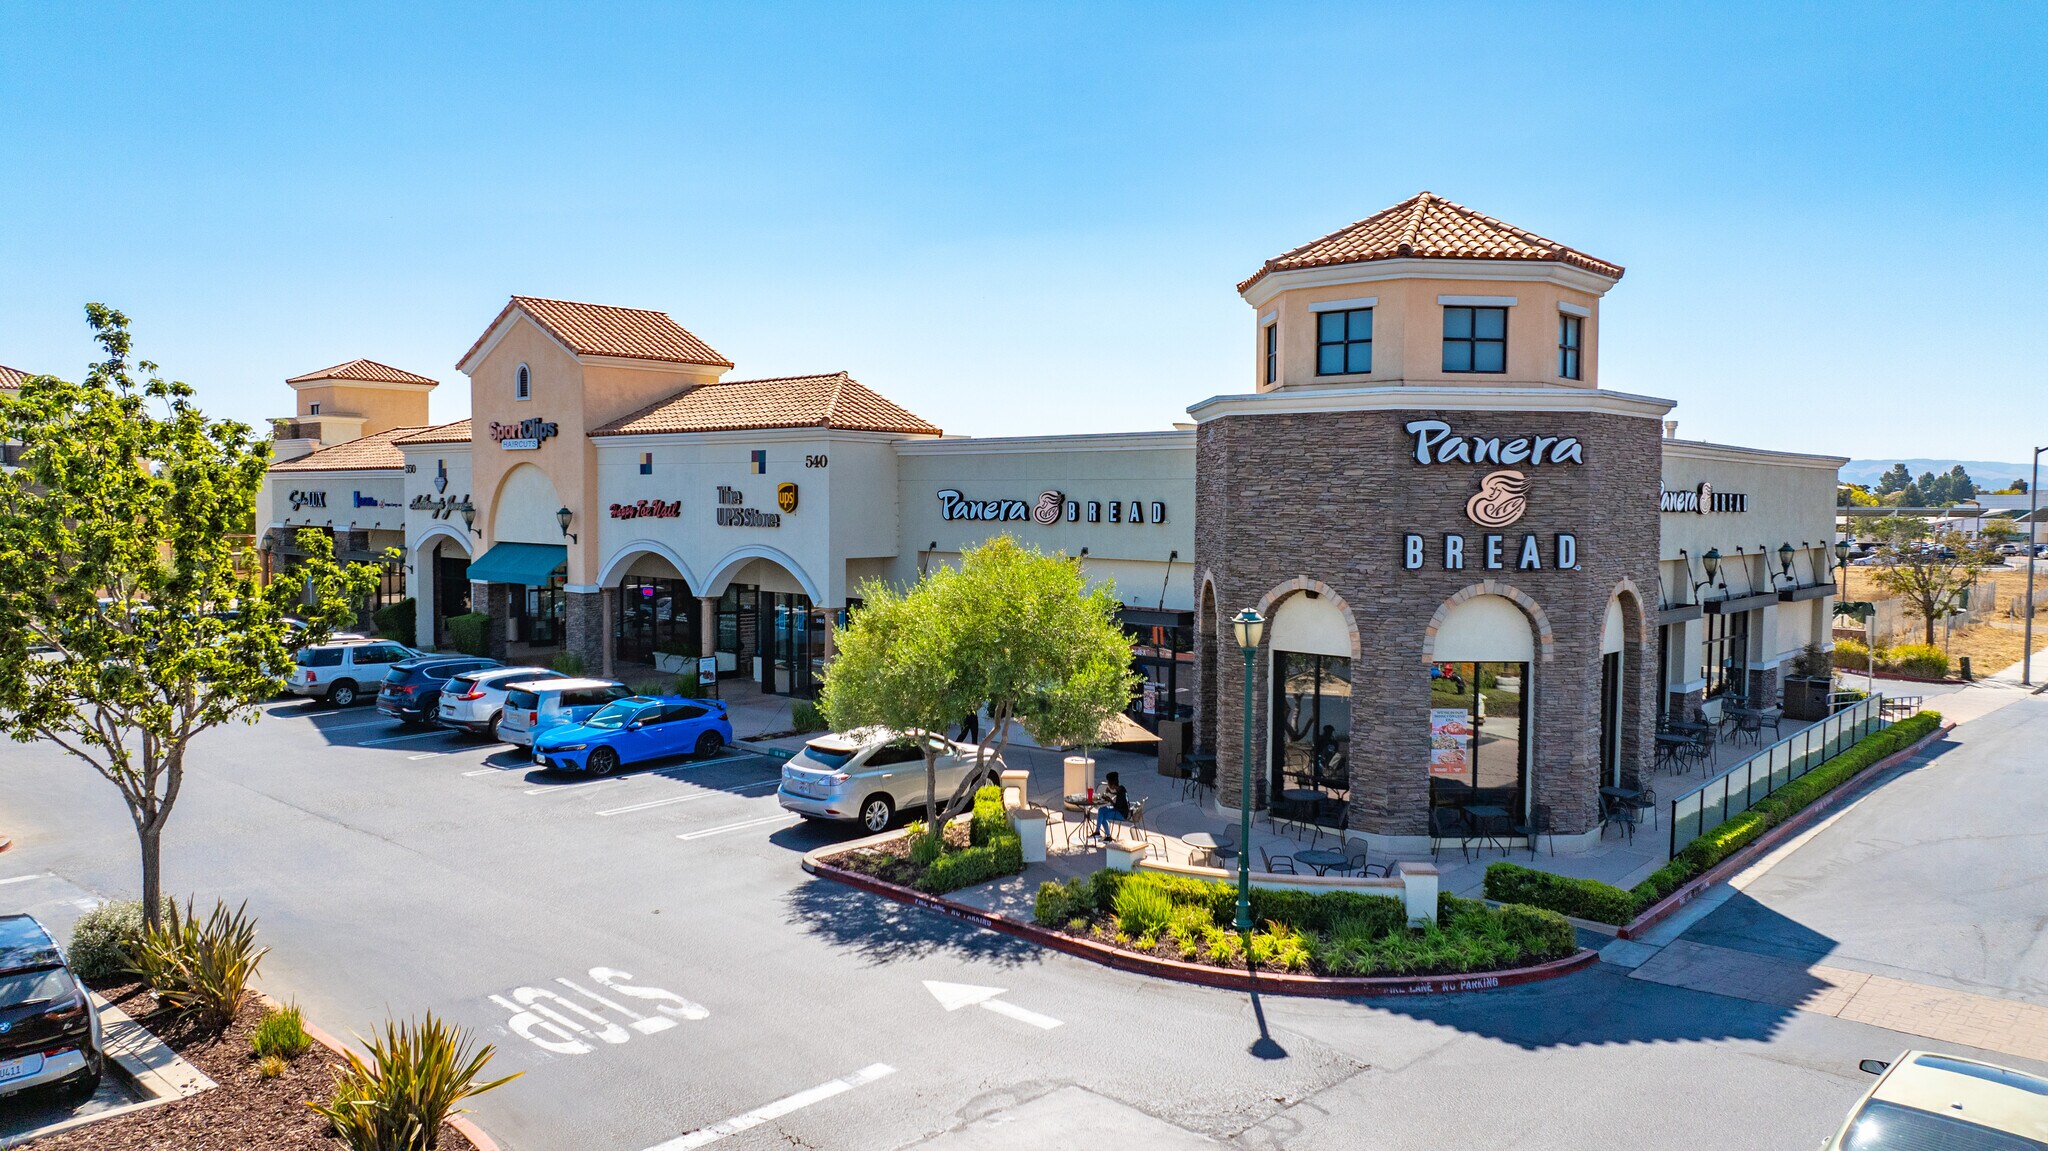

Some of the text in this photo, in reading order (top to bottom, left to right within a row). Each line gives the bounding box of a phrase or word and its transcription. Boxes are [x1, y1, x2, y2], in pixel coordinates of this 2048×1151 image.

[503, 440, 537, 448] HAIRCUTS
[1404, 419, 1583, 465] Panera
[805, 454, 828, 468] 540
[717, 486, 743, 504] The
[780, 492, 793, 508] ups
[652, 499, 681, 518] Nail
[937, 489, 1166, 523] Panera BREAD
[717, 507, 780, 527] UPS Store
[1403, 533, 1578, 571] BREAD
[1409, 982, 1434, 993] LANE
[1442, 982, 1456, 992] NO
[1460, 977, 1499, 990] PARKING
[487, 966, 710, 1055] STOP
